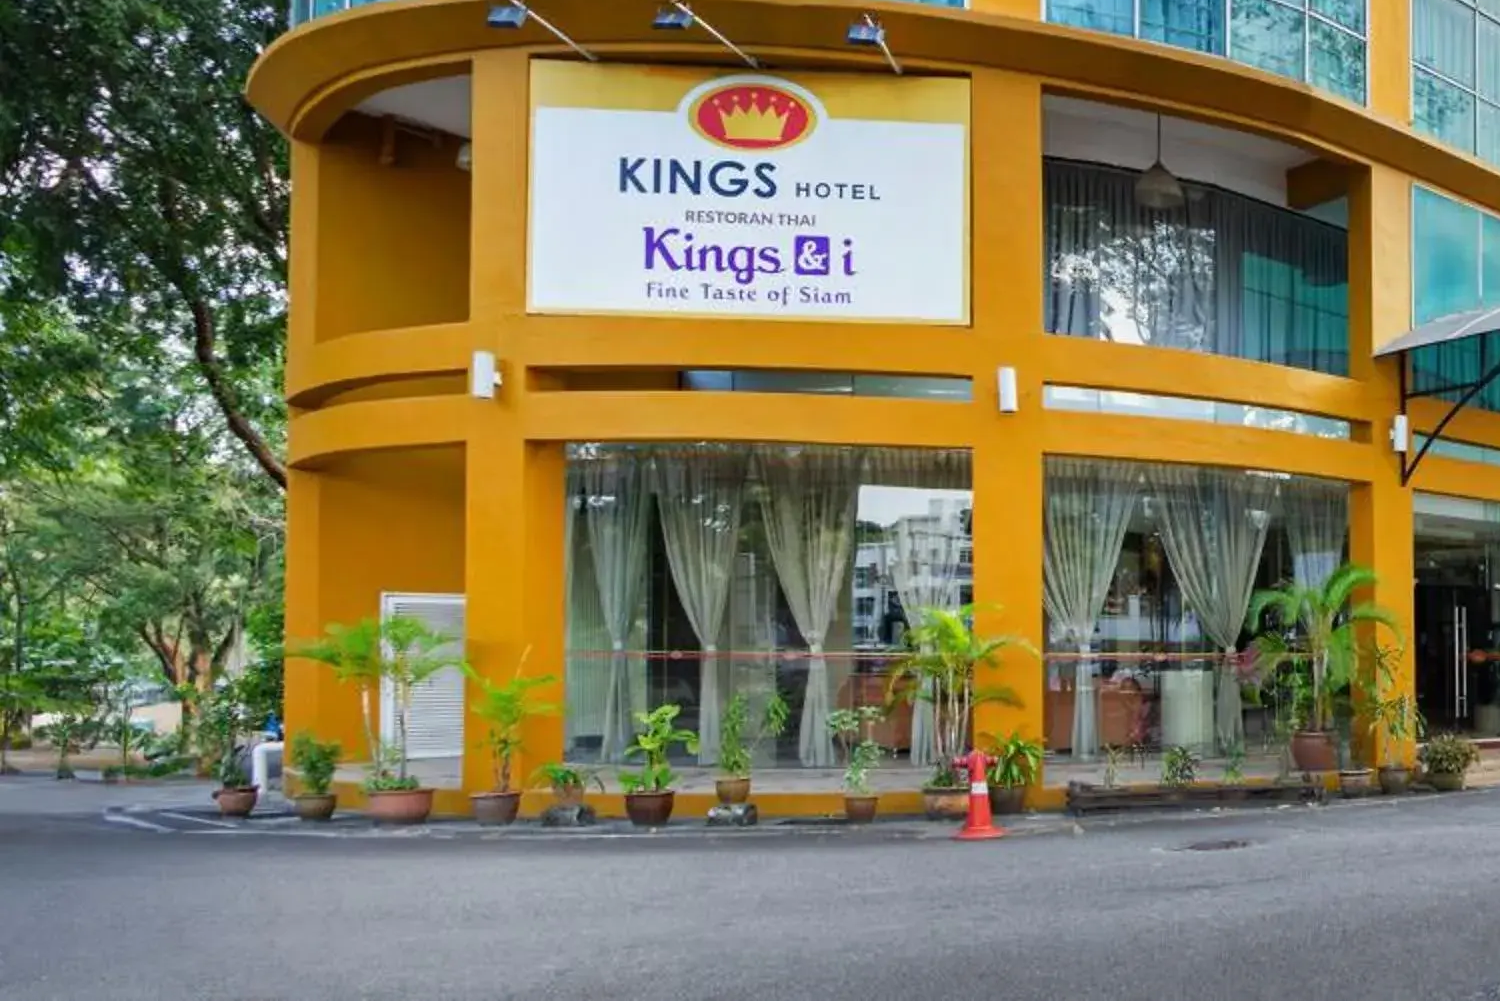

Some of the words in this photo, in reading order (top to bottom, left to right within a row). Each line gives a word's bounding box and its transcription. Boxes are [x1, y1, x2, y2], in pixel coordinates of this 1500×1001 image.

[618, 156, 778, 199] KINGS
[795, 181, 881, 201] HOTEL
[685, 209, 773, 226] RESTORAN
[777, 212, 816, 227] THAI
[642, 226, 785, 285] Kings
[796, 238, 830, 272] &
[841, 238, 858, 276] i
[645, 281, 690, 301] Fine
[700, 283, 757, 304] Taste
[767, 287, 789, 306] of
[799, 286, 852, 305] Siam
